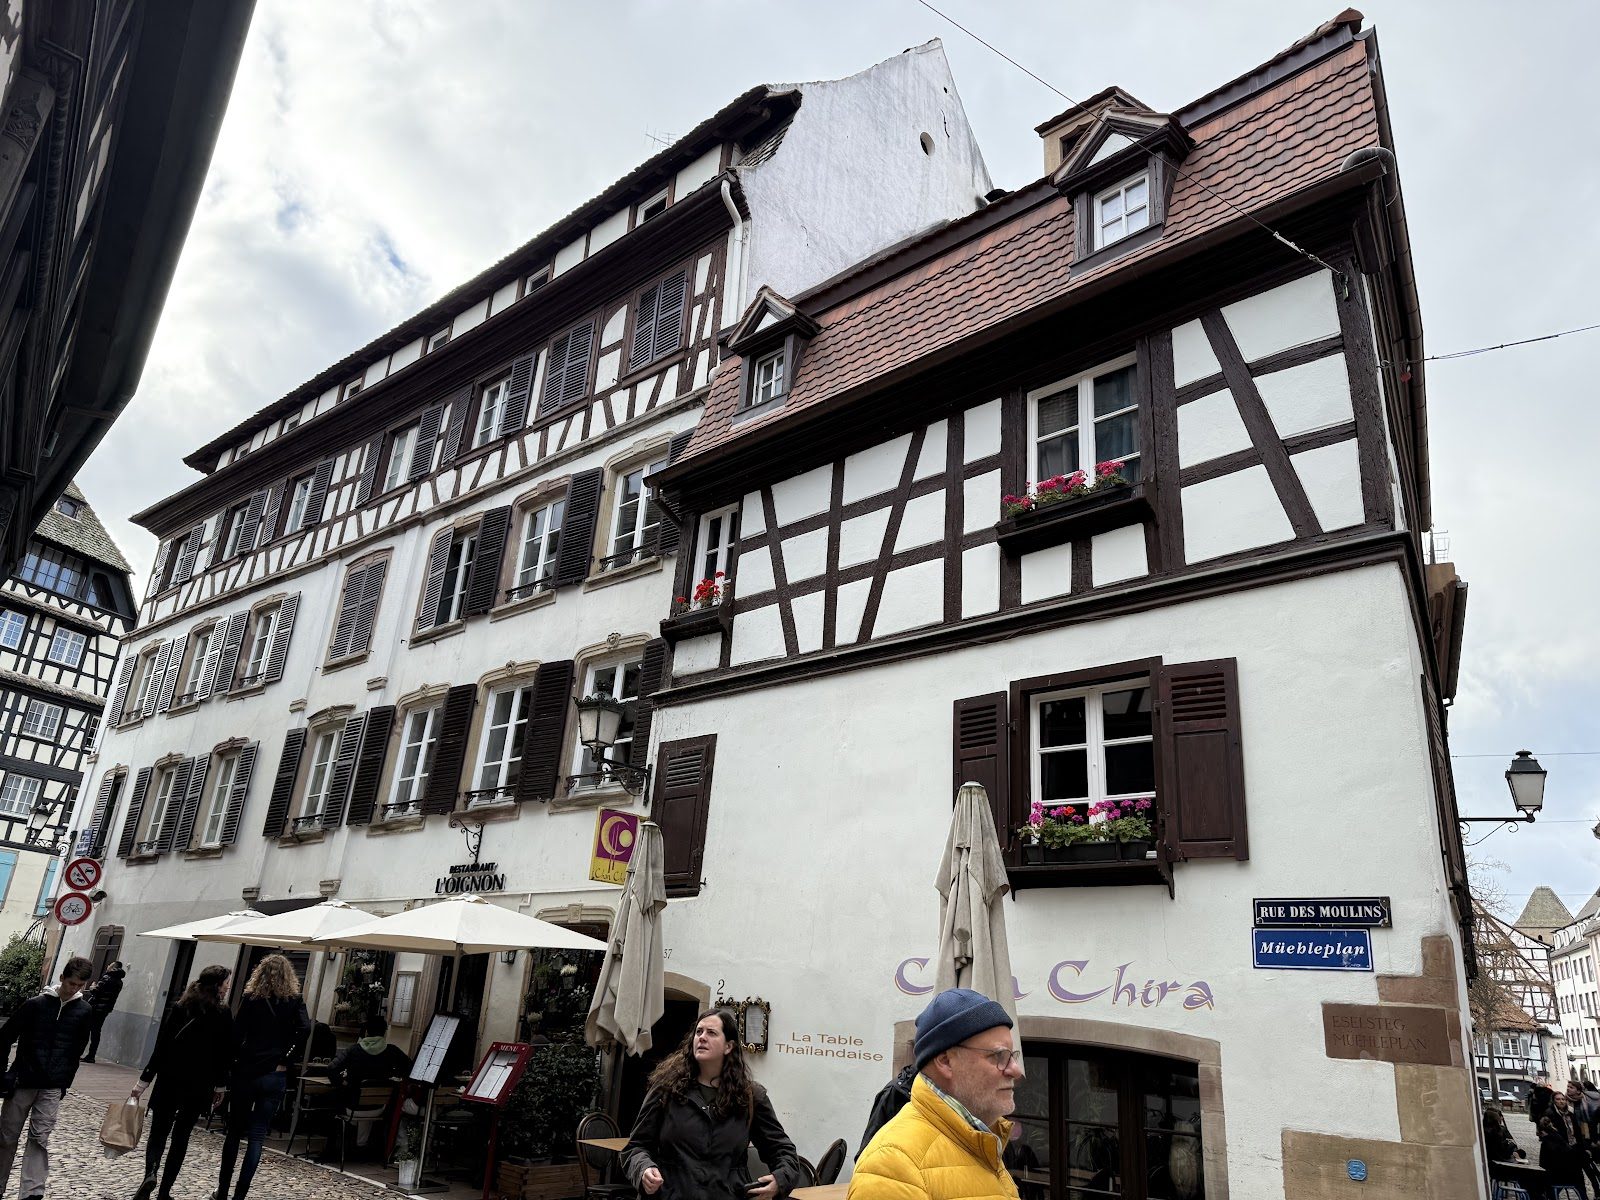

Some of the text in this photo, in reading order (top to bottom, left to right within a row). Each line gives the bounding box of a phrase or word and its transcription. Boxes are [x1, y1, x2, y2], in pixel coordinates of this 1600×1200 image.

[449, 862, 498, 874] RESTAURANT
[434, 873, 506, 894] L'OIGNON
[1260, 905, 1382, 918] RUE DES MOULINS
[1259, 941, 1366, 959] Müehleplan
[716, 978, 725, 995] 2
[1047, 959, 1216, 1011] Chira
[1332, 1015, 1406, 1031] ESELSTEG
[792, 1031, 864, 1047] La Table
[499, 1044, 519, 1053] MENU
[775, 1042, 884, 1062] Thaïlandaise
